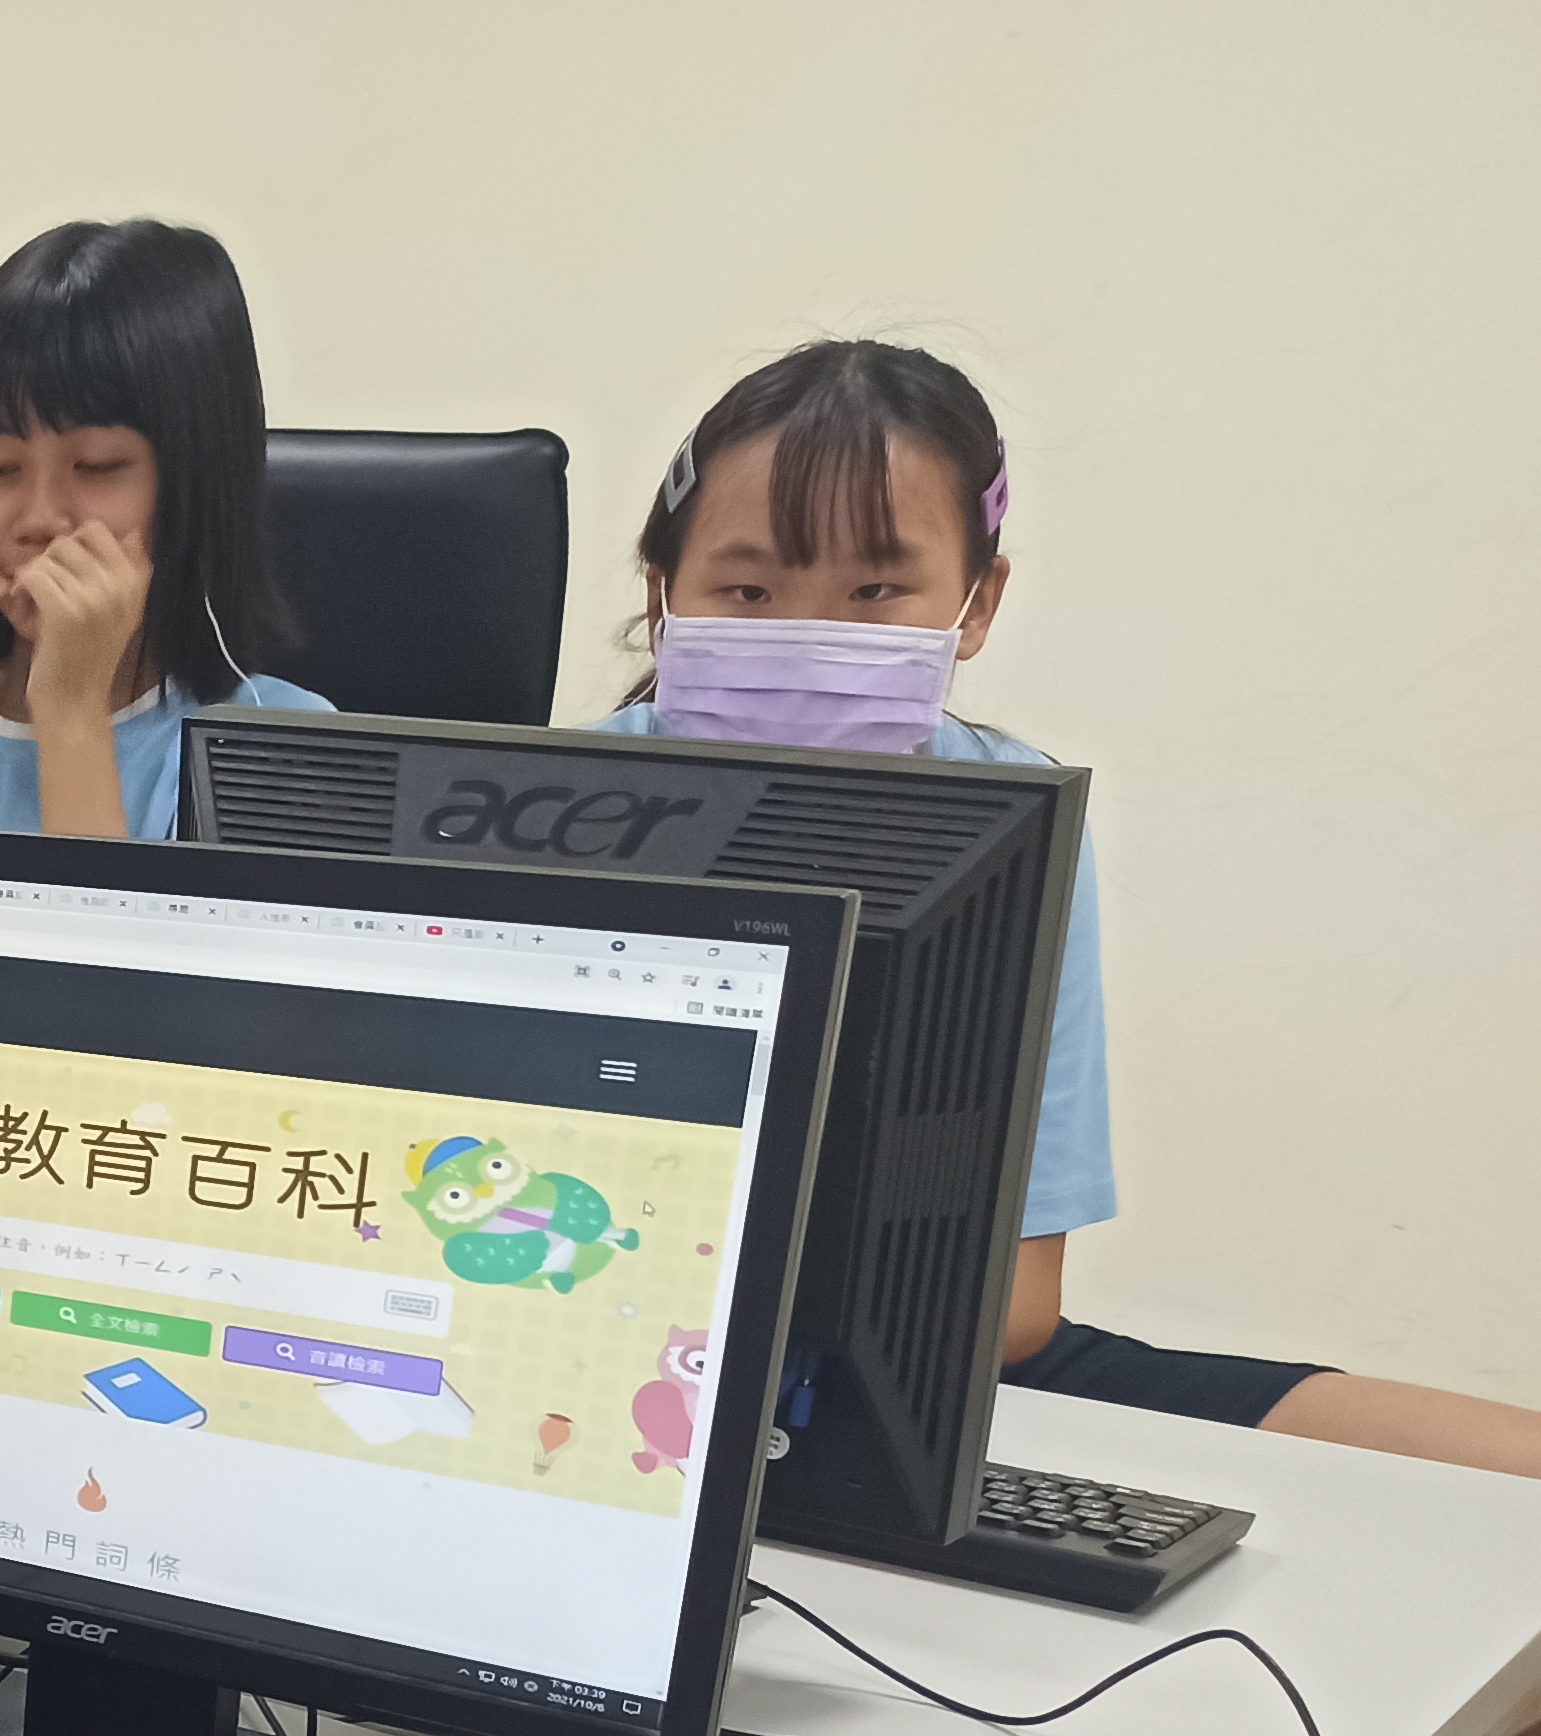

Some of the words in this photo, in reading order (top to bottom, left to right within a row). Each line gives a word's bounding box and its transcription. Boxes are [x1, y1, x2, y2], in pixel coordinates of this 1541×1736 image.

[422, 779, 703, 861] acer
[733, 920, 791, 936] V196WL
[89, 1311, 162, 1338] 全文檢索
[46, 1615, 119, 1644] acer
